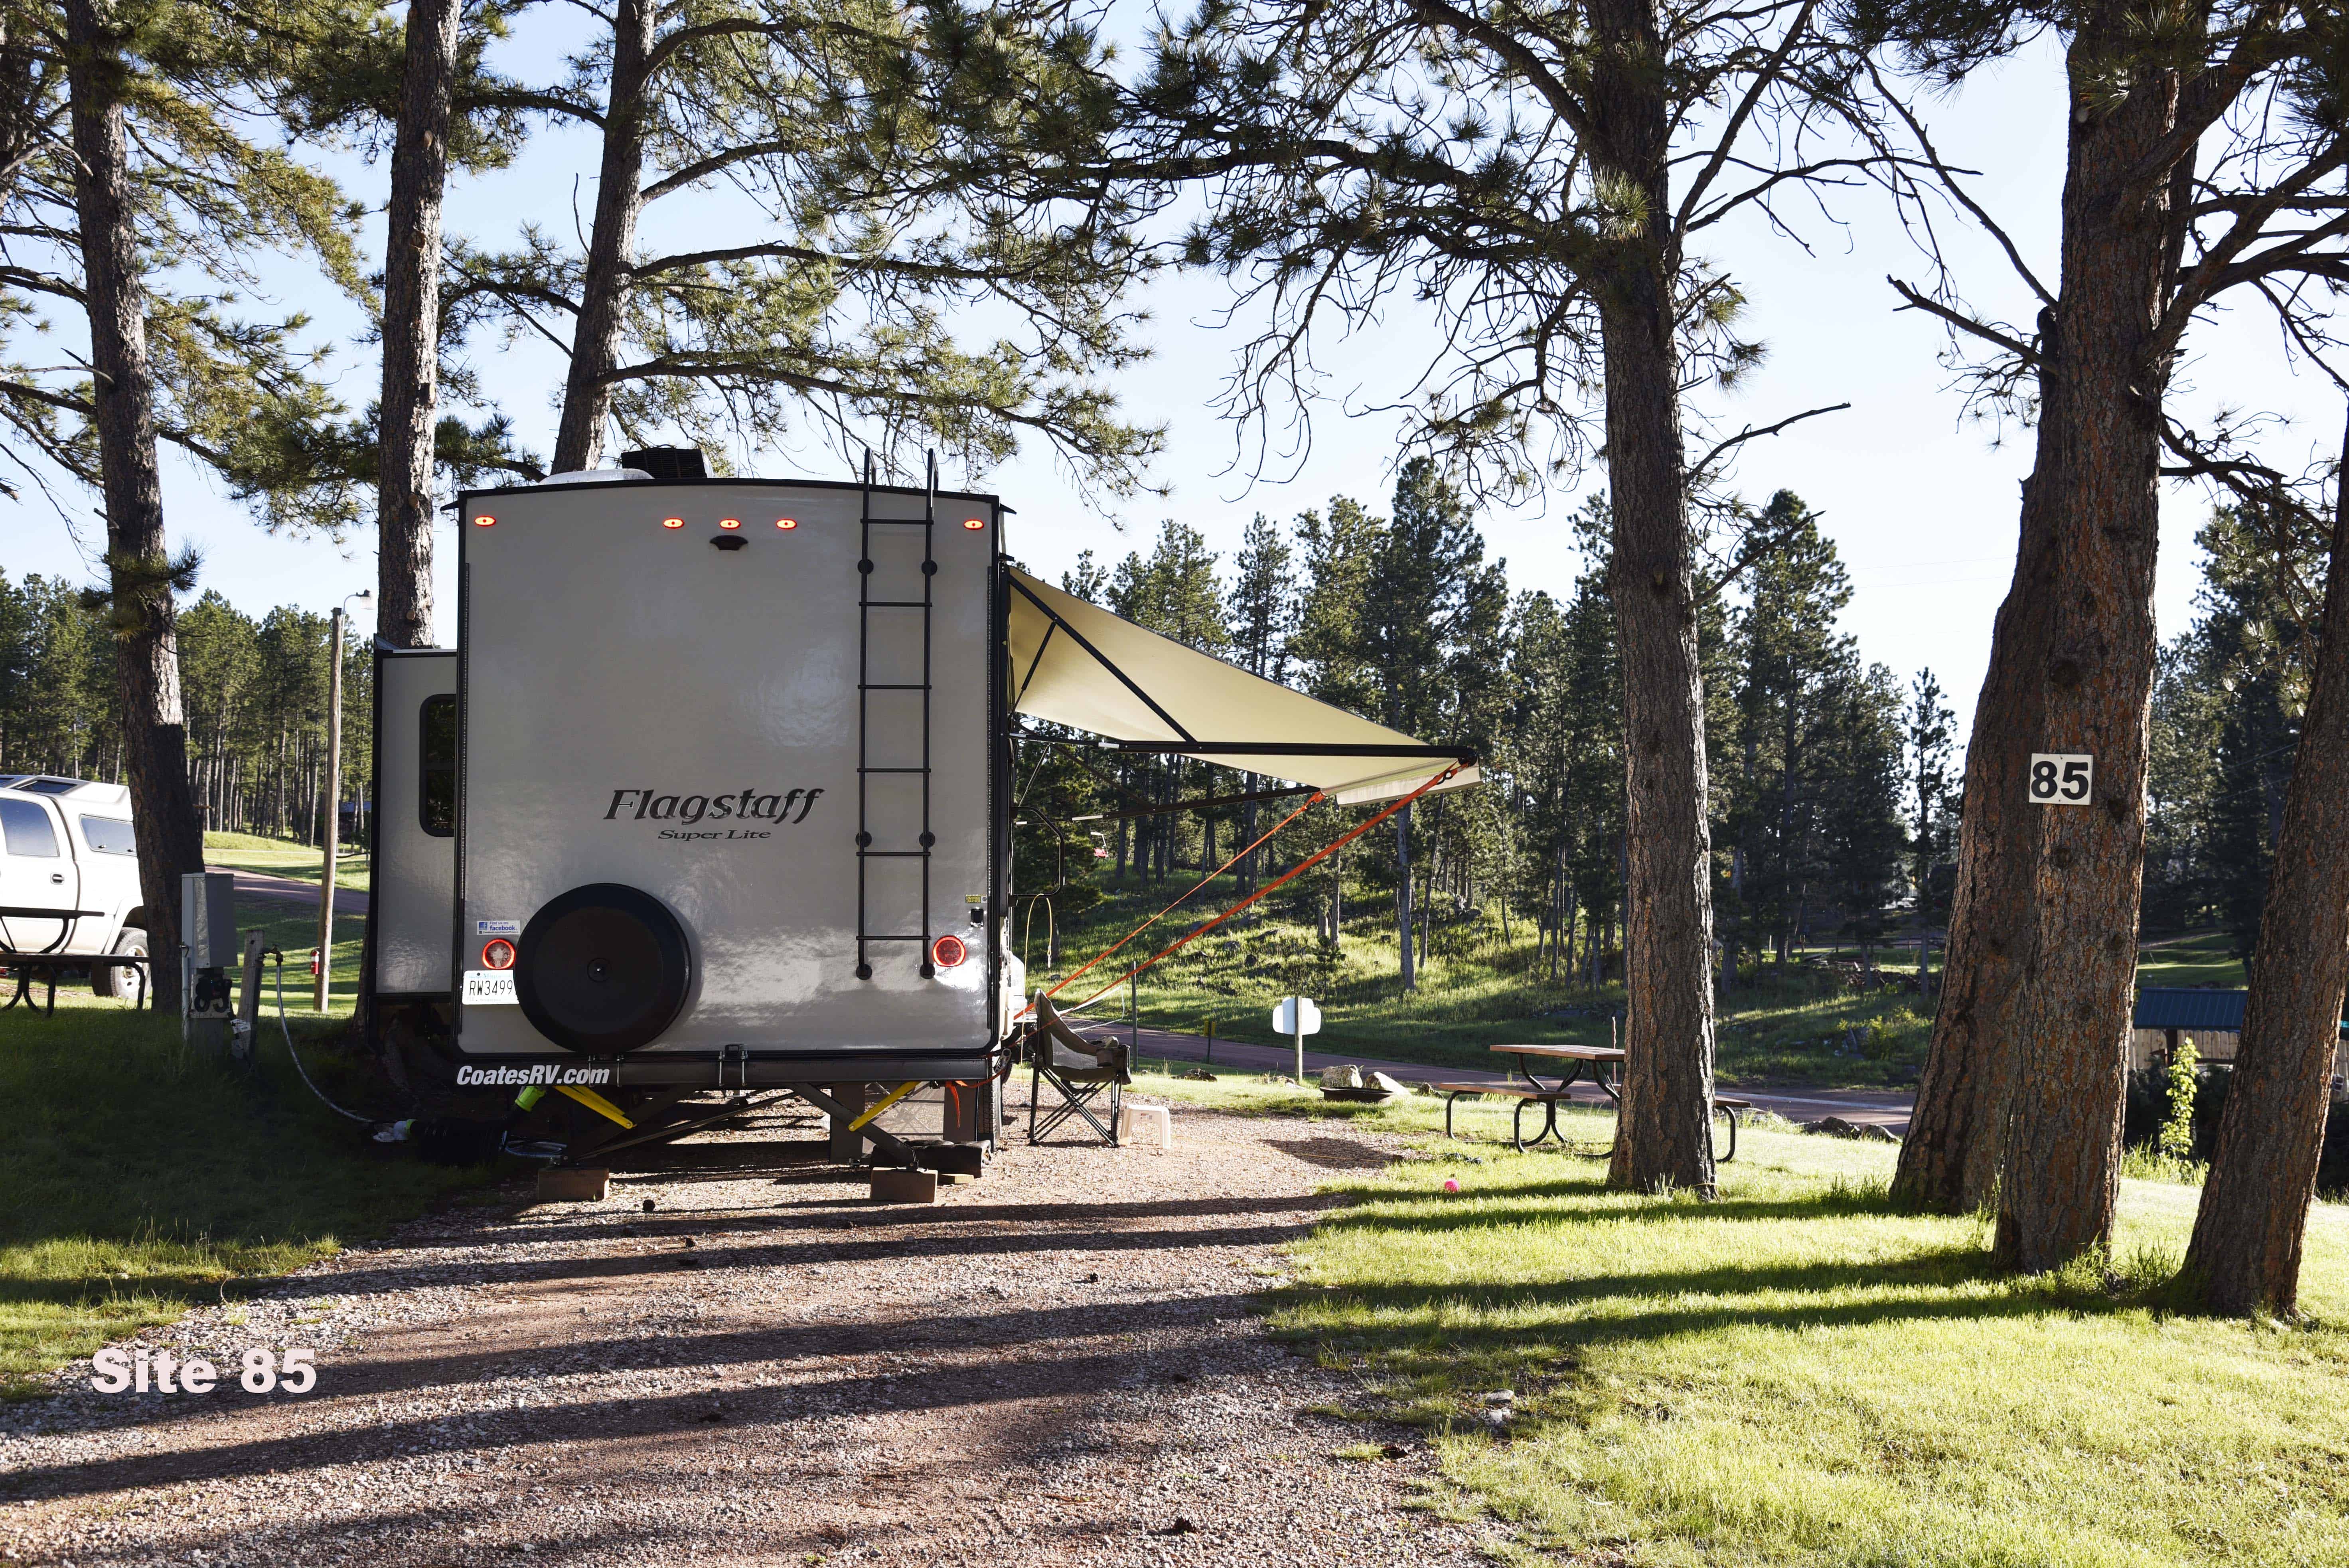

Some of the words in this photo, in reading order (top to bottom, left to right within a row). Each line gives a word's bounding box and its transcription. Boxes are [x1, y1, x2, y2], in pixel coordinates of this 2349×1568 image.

[2031, 761, 2089, 800] 85
[603, 788, 825, 825] Flagstaff
[658, 830, 723, 841] Super
[724, 830, 772, 839] Lite
[456, 1065, 610, 1085] CoatesRV.com
